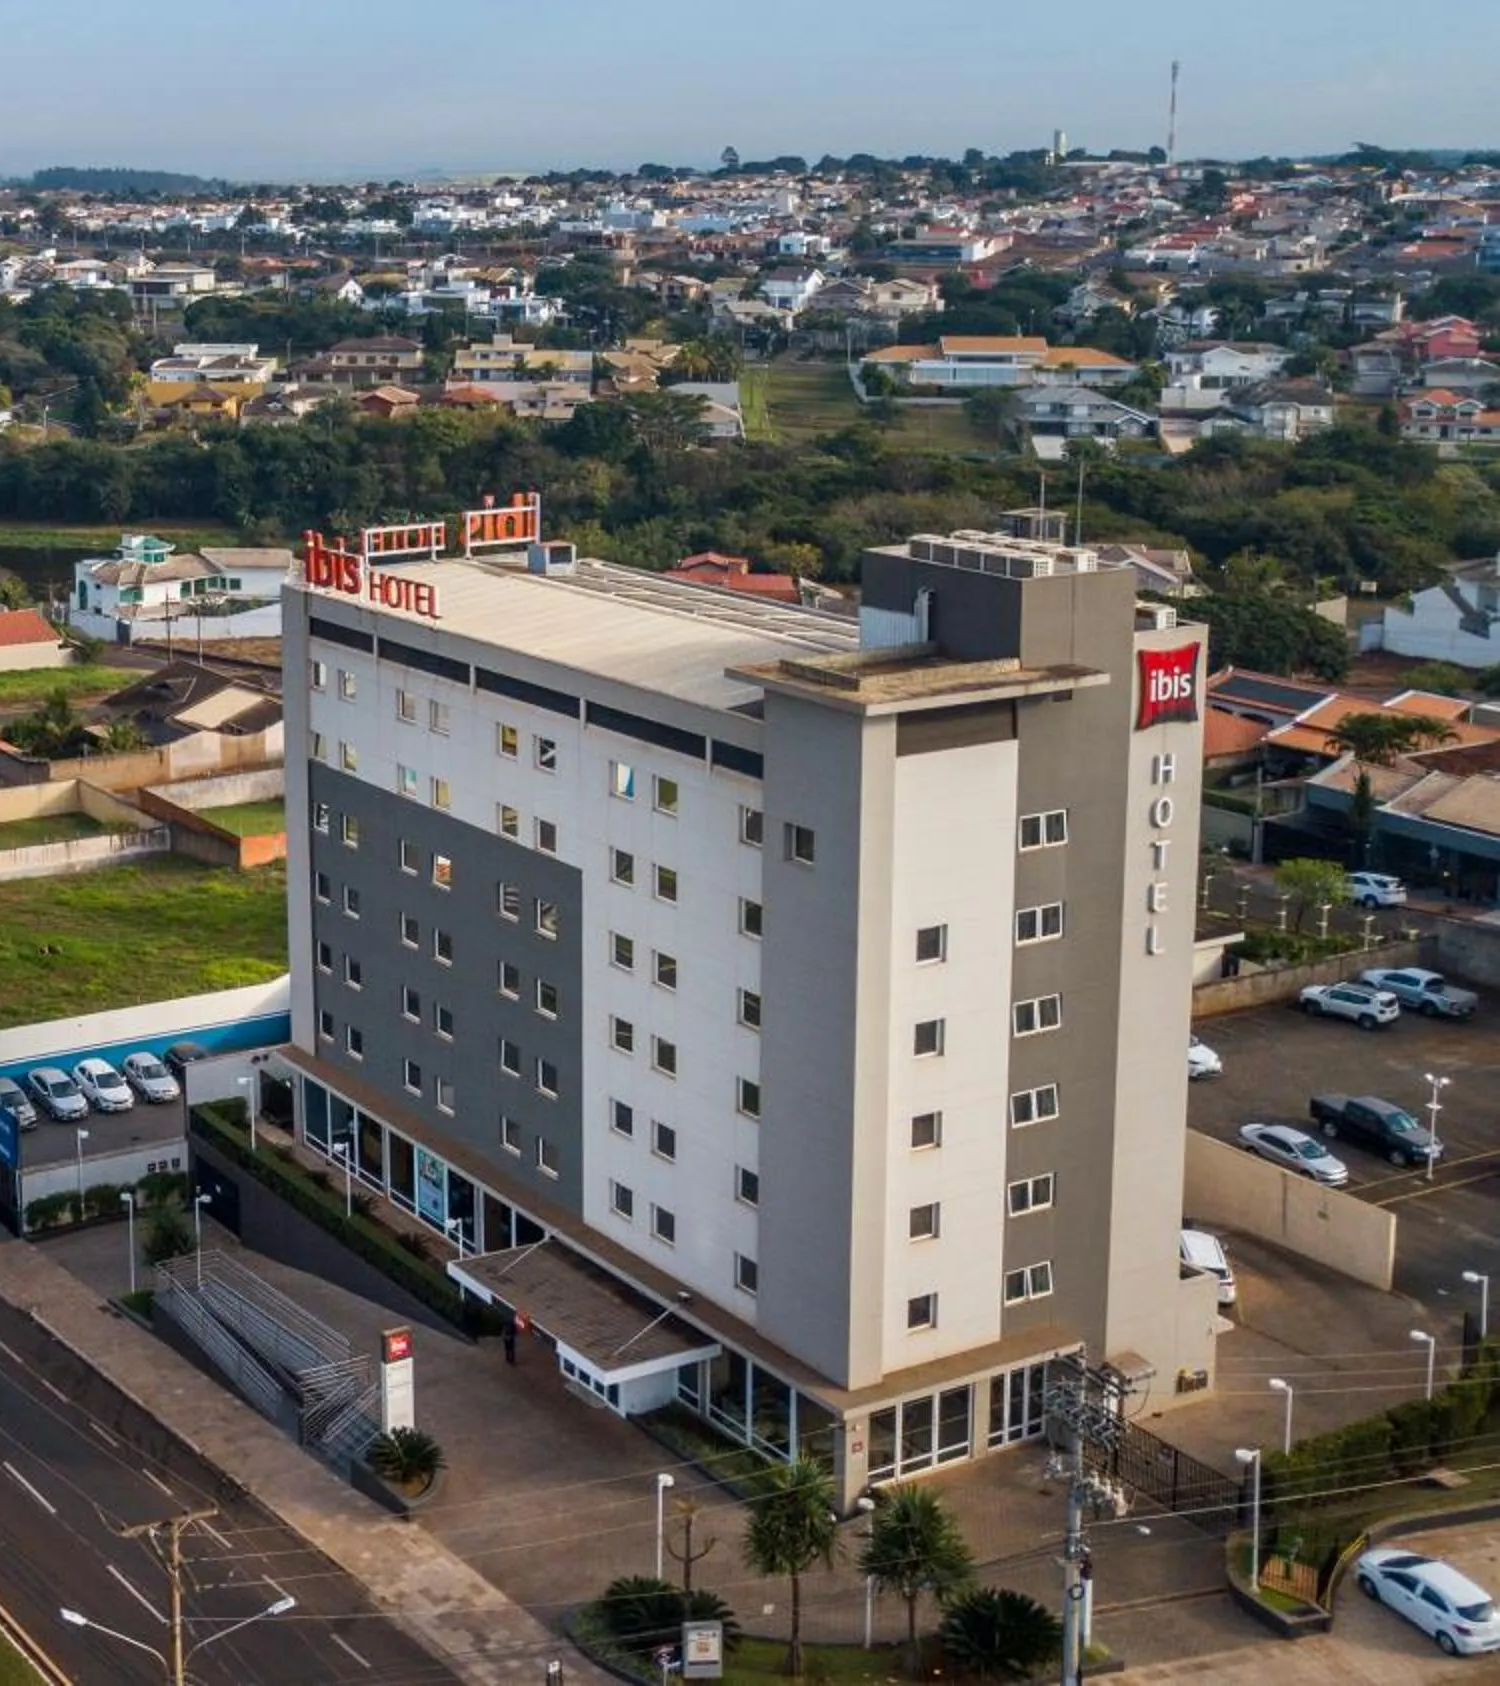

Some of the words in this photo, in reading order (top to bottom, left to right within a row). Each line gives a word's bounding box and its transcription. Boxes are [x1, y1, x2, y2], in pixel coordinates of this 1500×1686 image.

[304, 529, 361, 594] ibis
[368, 571, 442, 619] HOTEL
[1150, 666, 1191, 703] ibis
[1147, 753, 1176, 955] HOTEL
